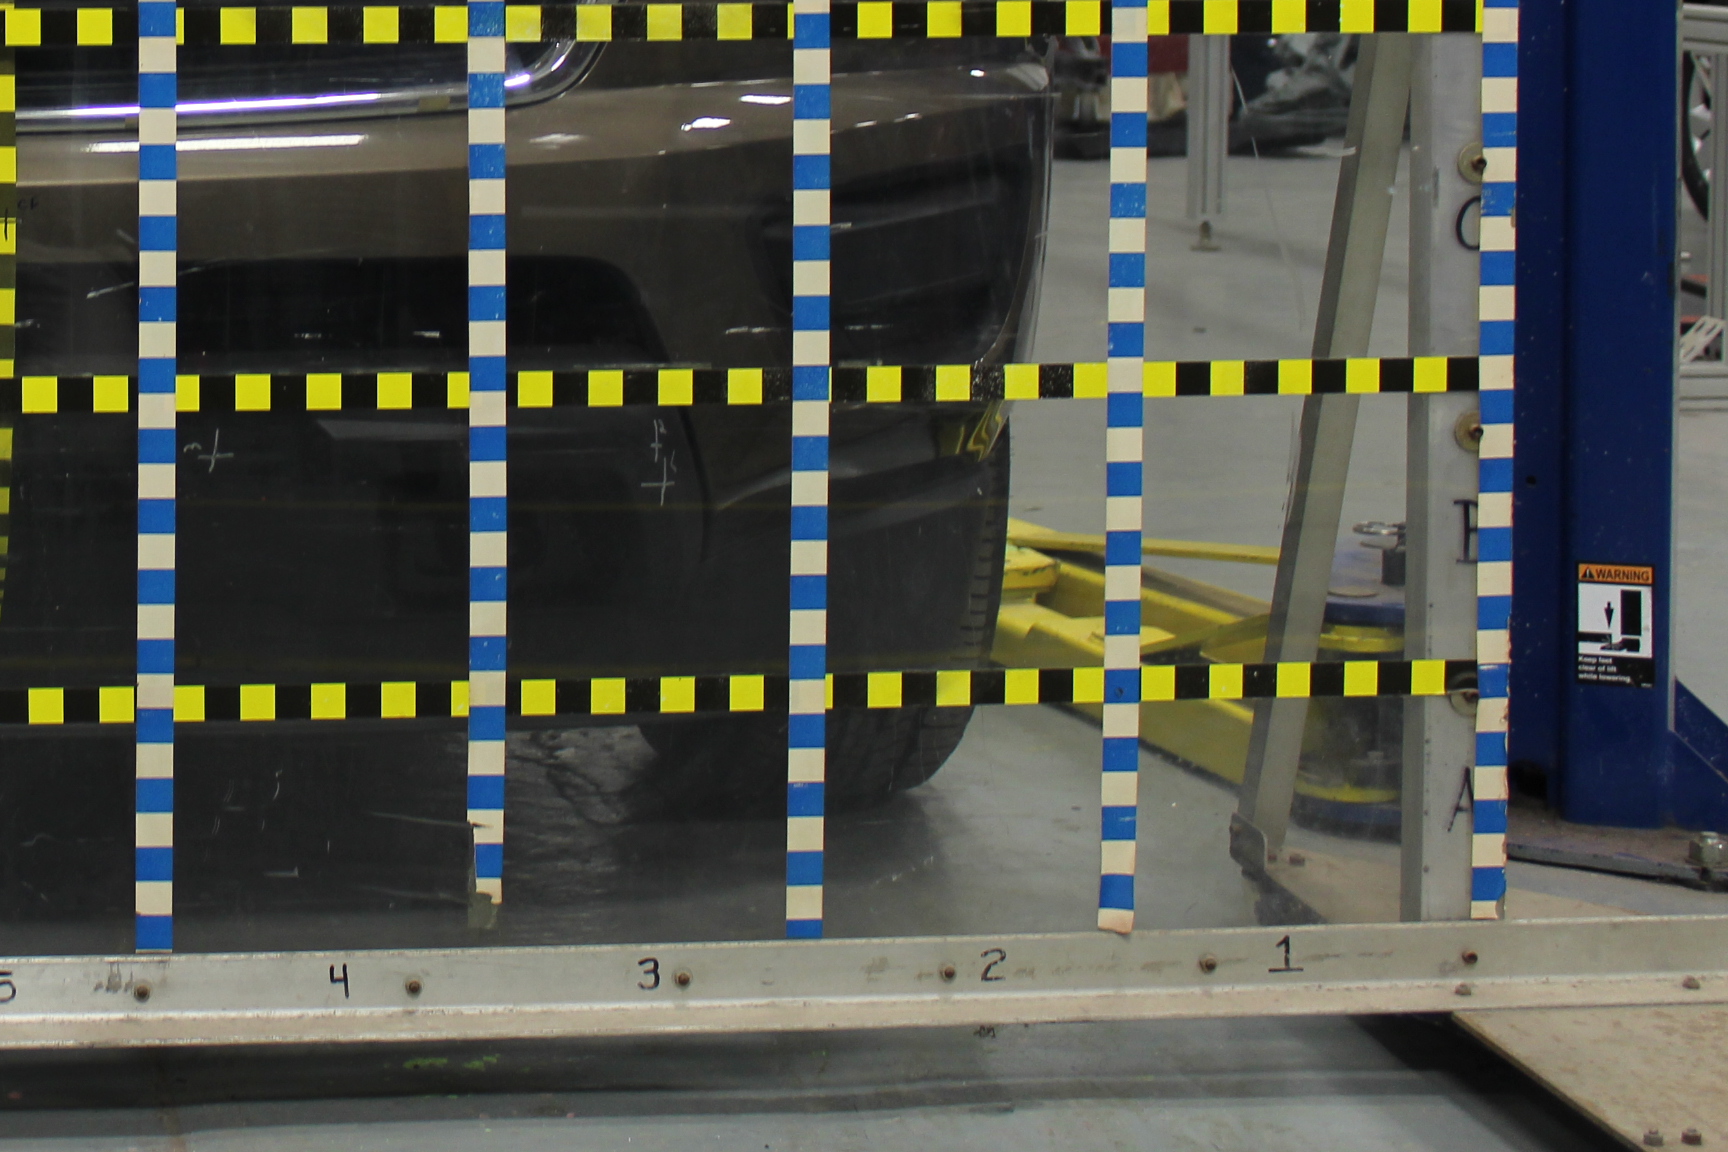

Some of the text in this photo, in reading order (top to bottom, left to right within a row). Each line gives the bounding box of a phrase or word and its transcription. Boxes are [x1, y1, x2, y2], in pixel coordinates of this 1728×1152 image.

[1595, 568, 1651, 582] WARNING
[980, 948, 1007, 982] 2
[1268, 934, 1304, 974] 1
[328, 962, 350, 1000] 4
[636, 957, 661, 991] 3
